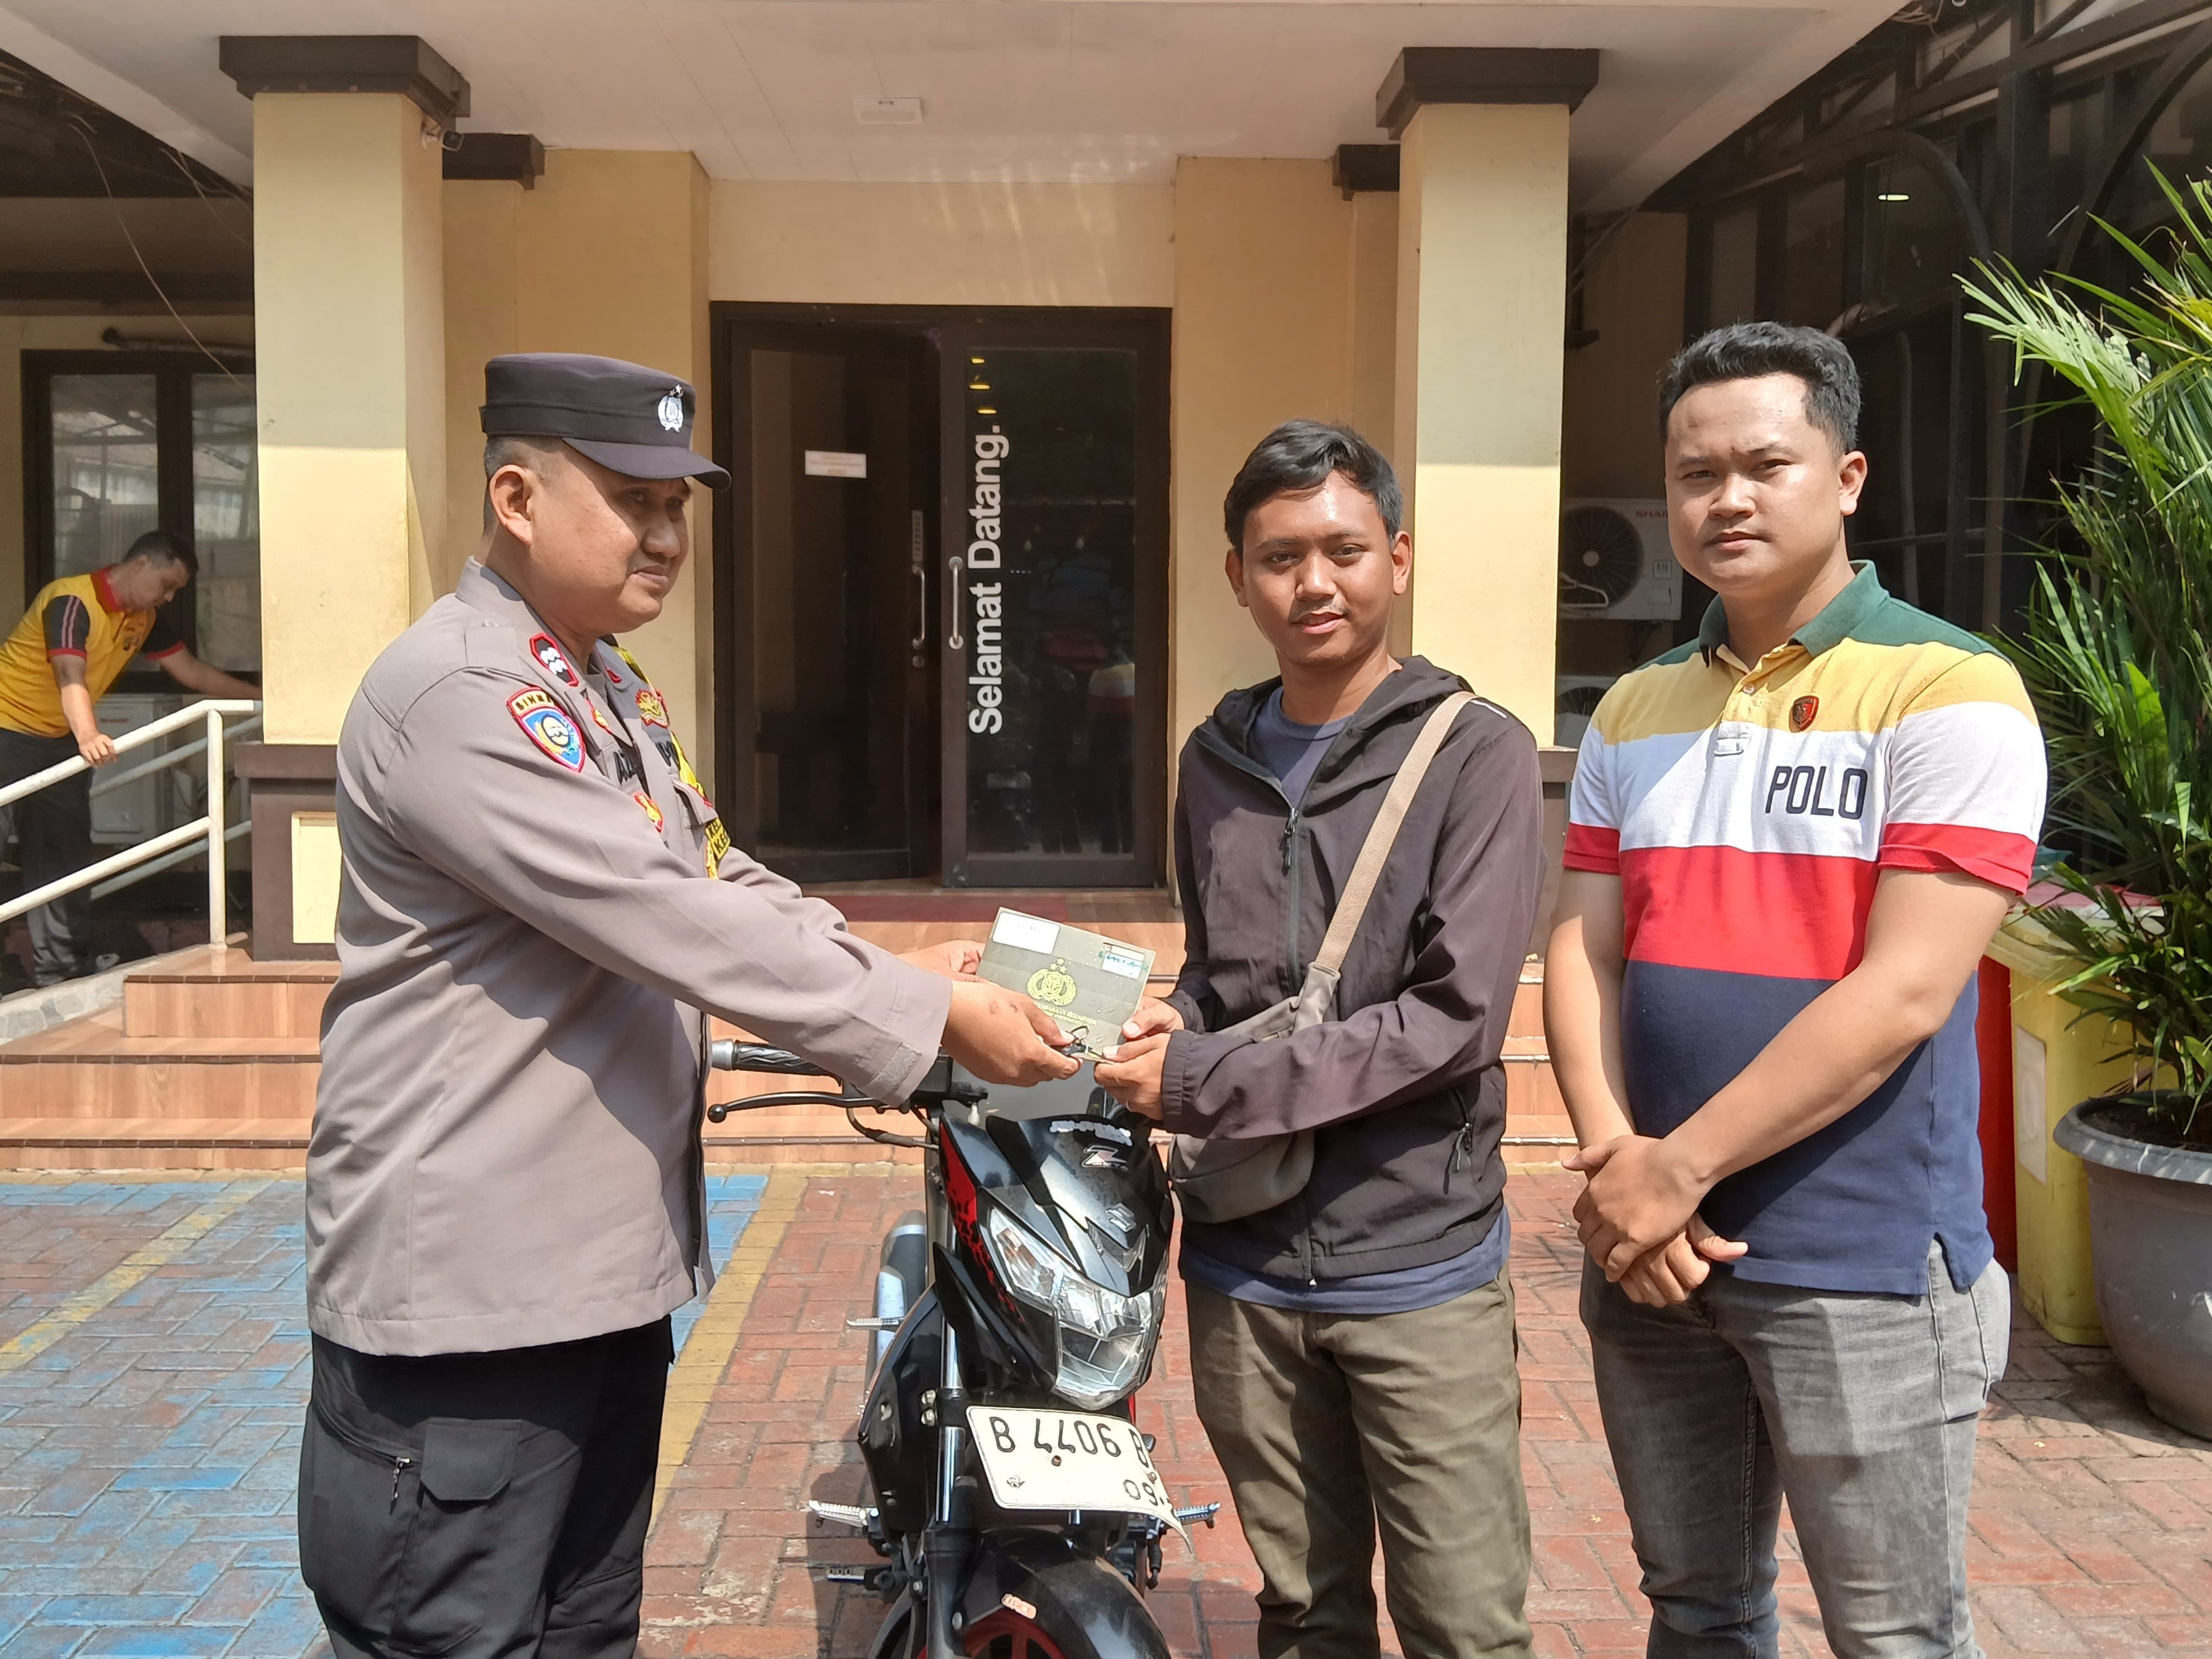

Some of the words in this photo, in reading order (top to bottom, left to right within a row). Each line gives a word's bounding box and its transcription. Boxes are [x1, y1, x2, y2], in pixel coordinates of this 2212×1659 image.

[967, 425, 1009, 569] Datang.
[968, 582, 1003, 735] Selamat
[515, 694, 552, 711] BINMA
[1765, 766, 1868, 820] POLO
[989, 1416, 1016, 1453] B
[1034, 1418, 1121, 1457] 4406
